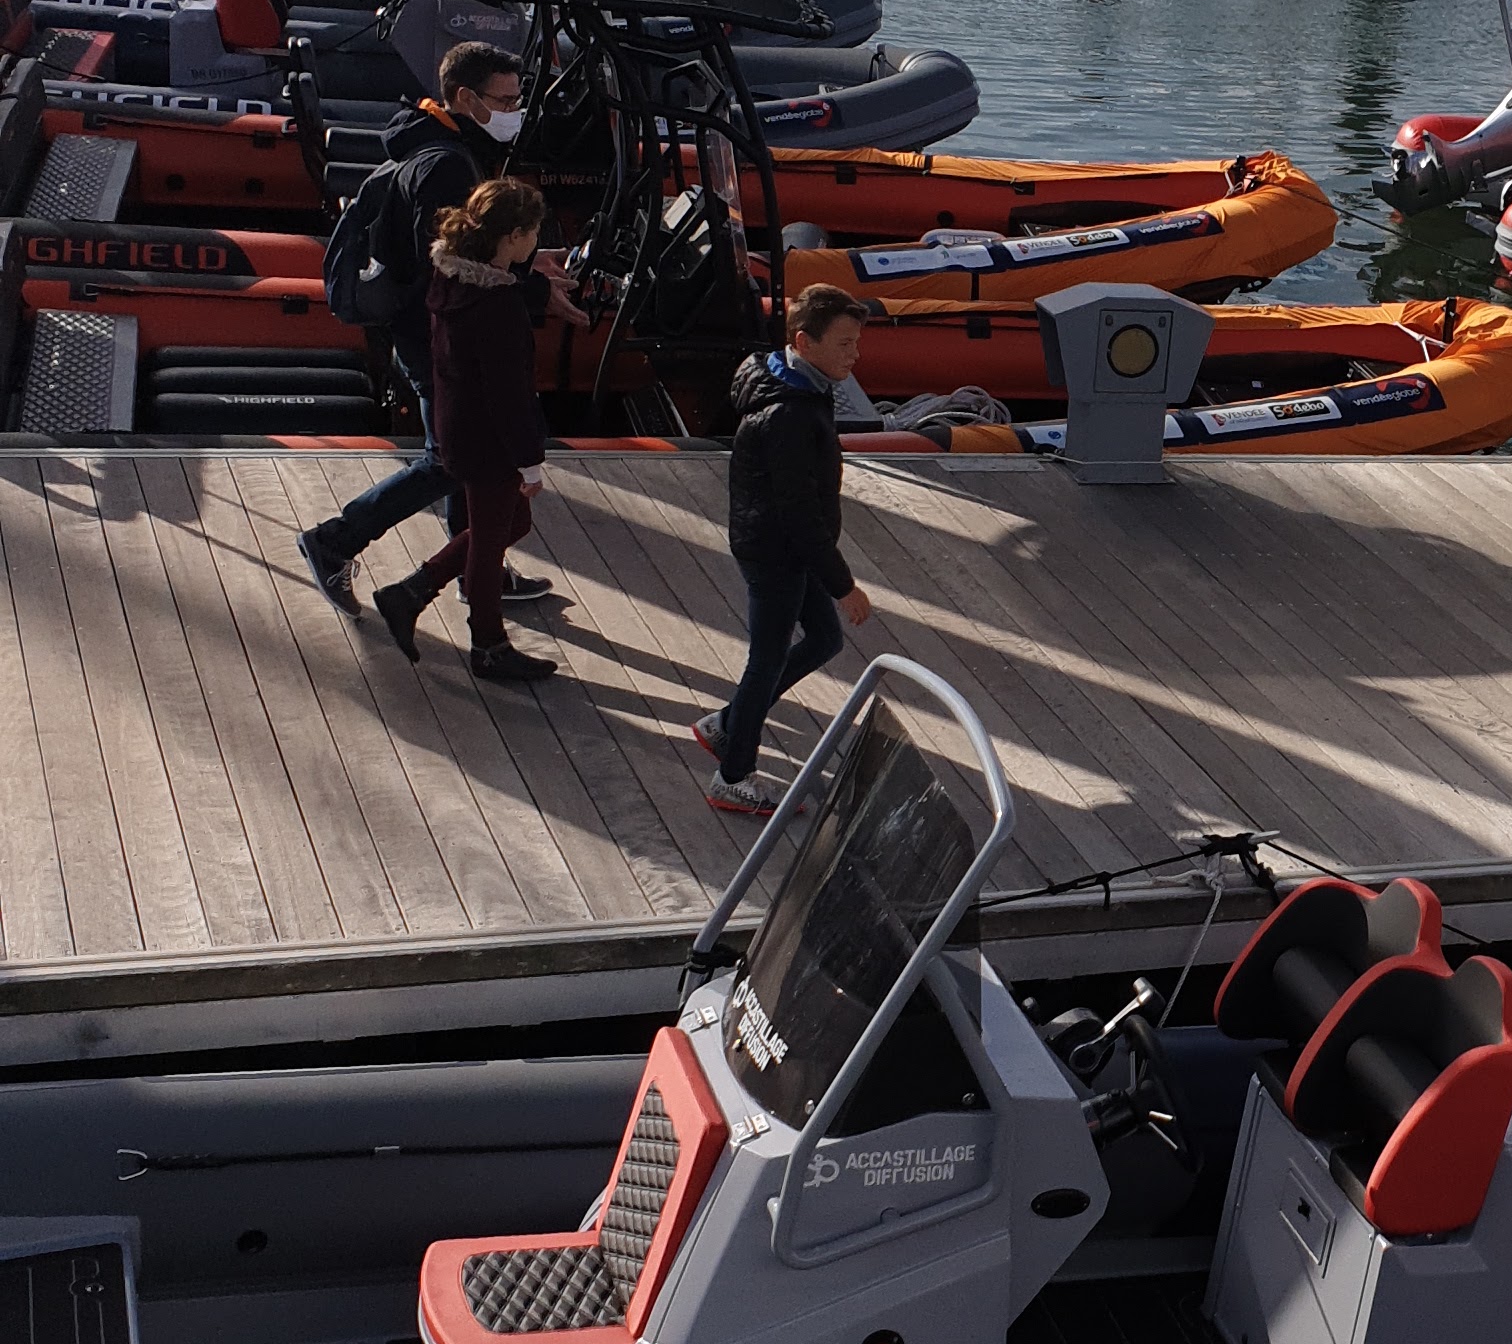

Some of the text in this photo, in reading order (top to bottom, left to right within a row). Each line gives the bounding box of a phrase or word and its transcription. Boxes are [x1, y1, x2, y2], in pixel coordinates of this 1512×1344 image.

[1070, 231, 1115, 247] Sodebo
[19, 235, 228, 270] GHFIELD
[1273, 400, 1325, 419] Sodebo
[745, 987, 789, 1065] ACCASTILLAGE
[845, 1144, 976, 1170] ACCASTILLAGE
[864, 1163, 955, 1186] DIFFUSION
